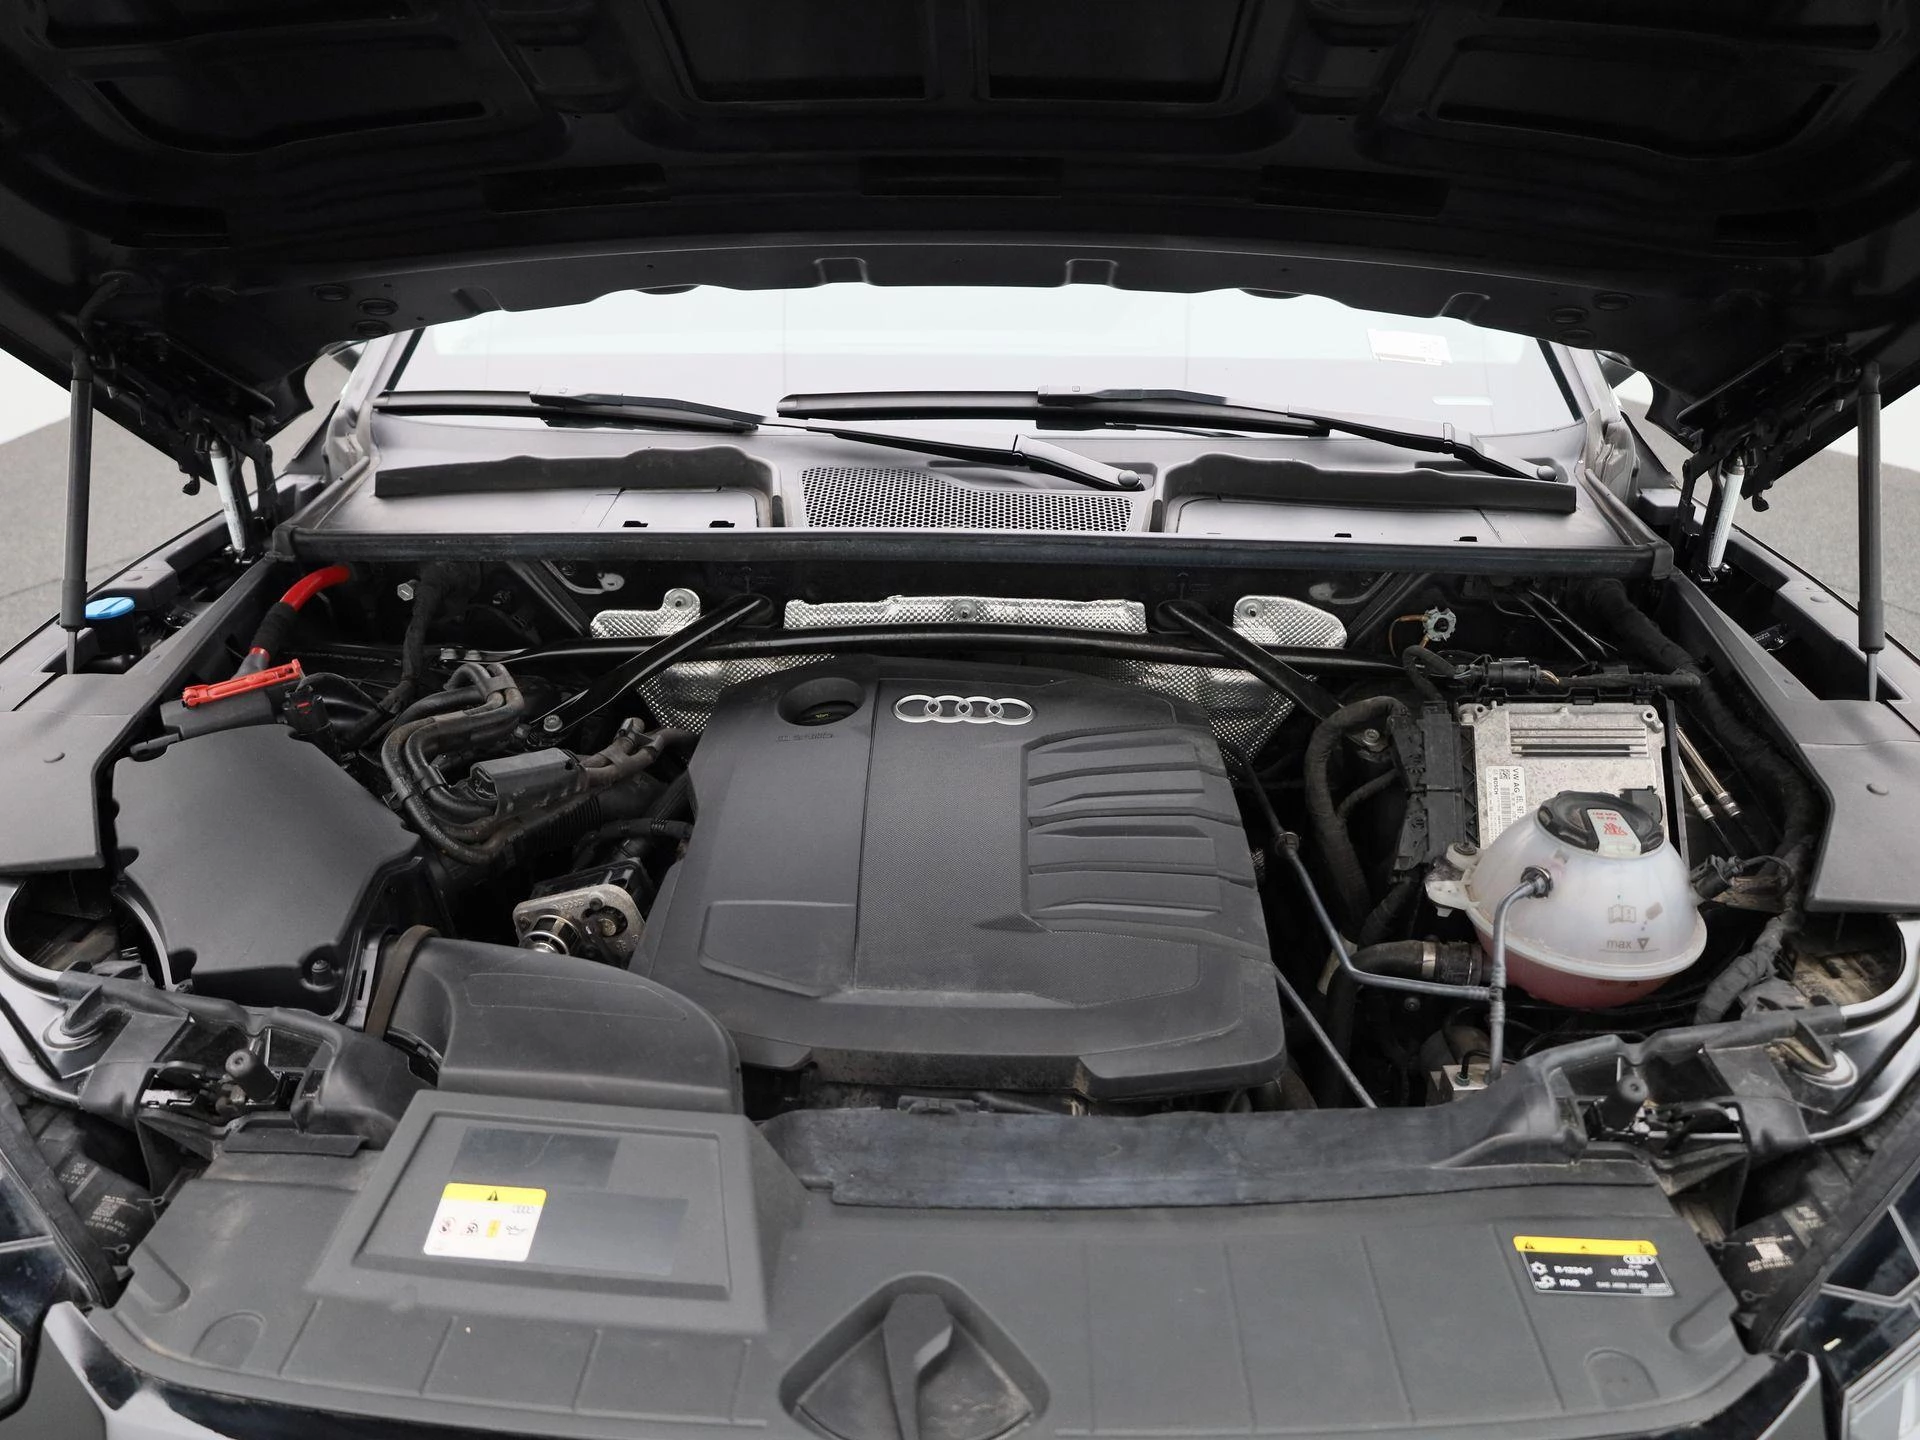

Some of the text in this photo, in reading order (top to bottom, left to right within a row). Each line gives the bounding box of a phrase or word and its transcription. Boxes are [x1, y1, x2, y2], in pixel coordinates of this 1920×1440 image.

[1512, 768, 1520, 781] VW
[1513, 782, 1521, 794] AG
[1606, 939, 1633, 950] max
